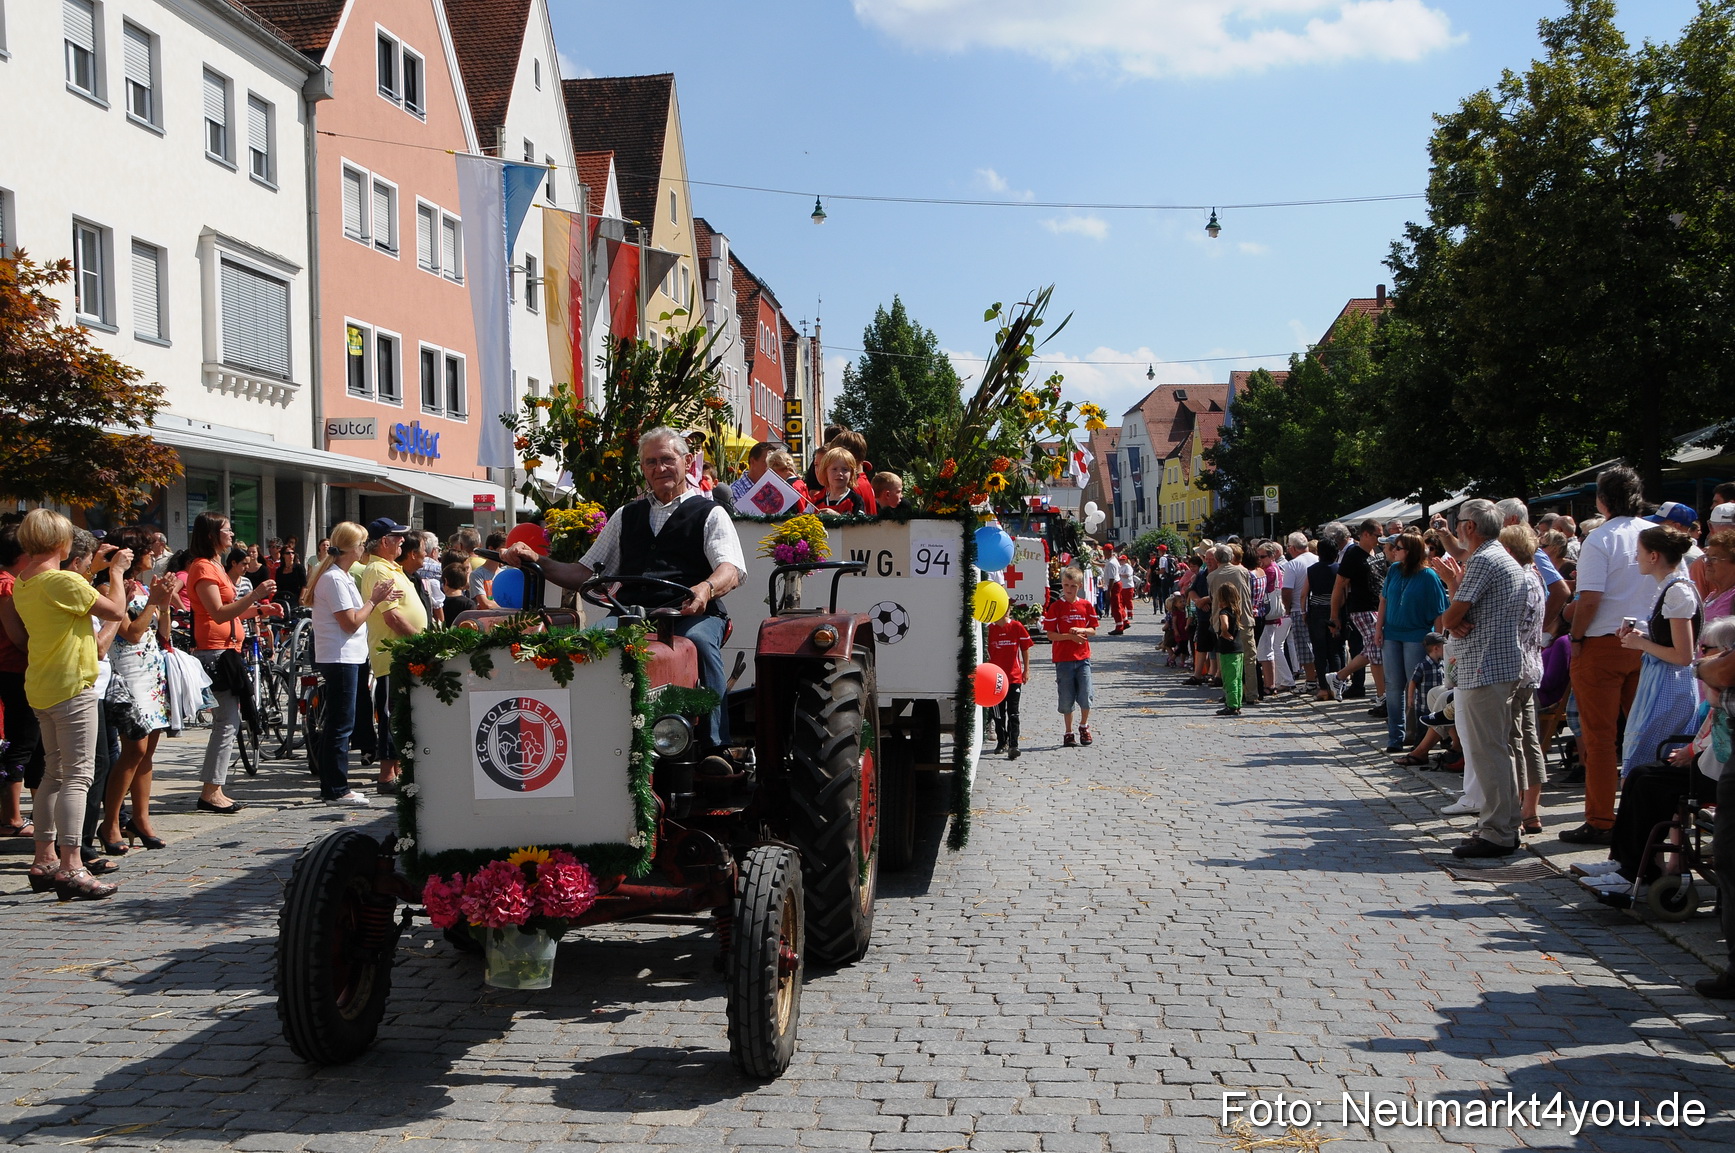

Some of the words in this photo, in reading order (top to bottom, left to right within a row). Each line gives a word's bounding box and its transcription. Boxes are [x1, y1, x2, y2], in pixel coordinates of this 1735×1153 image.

[915, 548, 950, 576] 94
[1015, 593, 1034, 601] 2013
[480, 699, 561, 733] HOLZHEIM
[477, 740, 490, 763] F.C.
